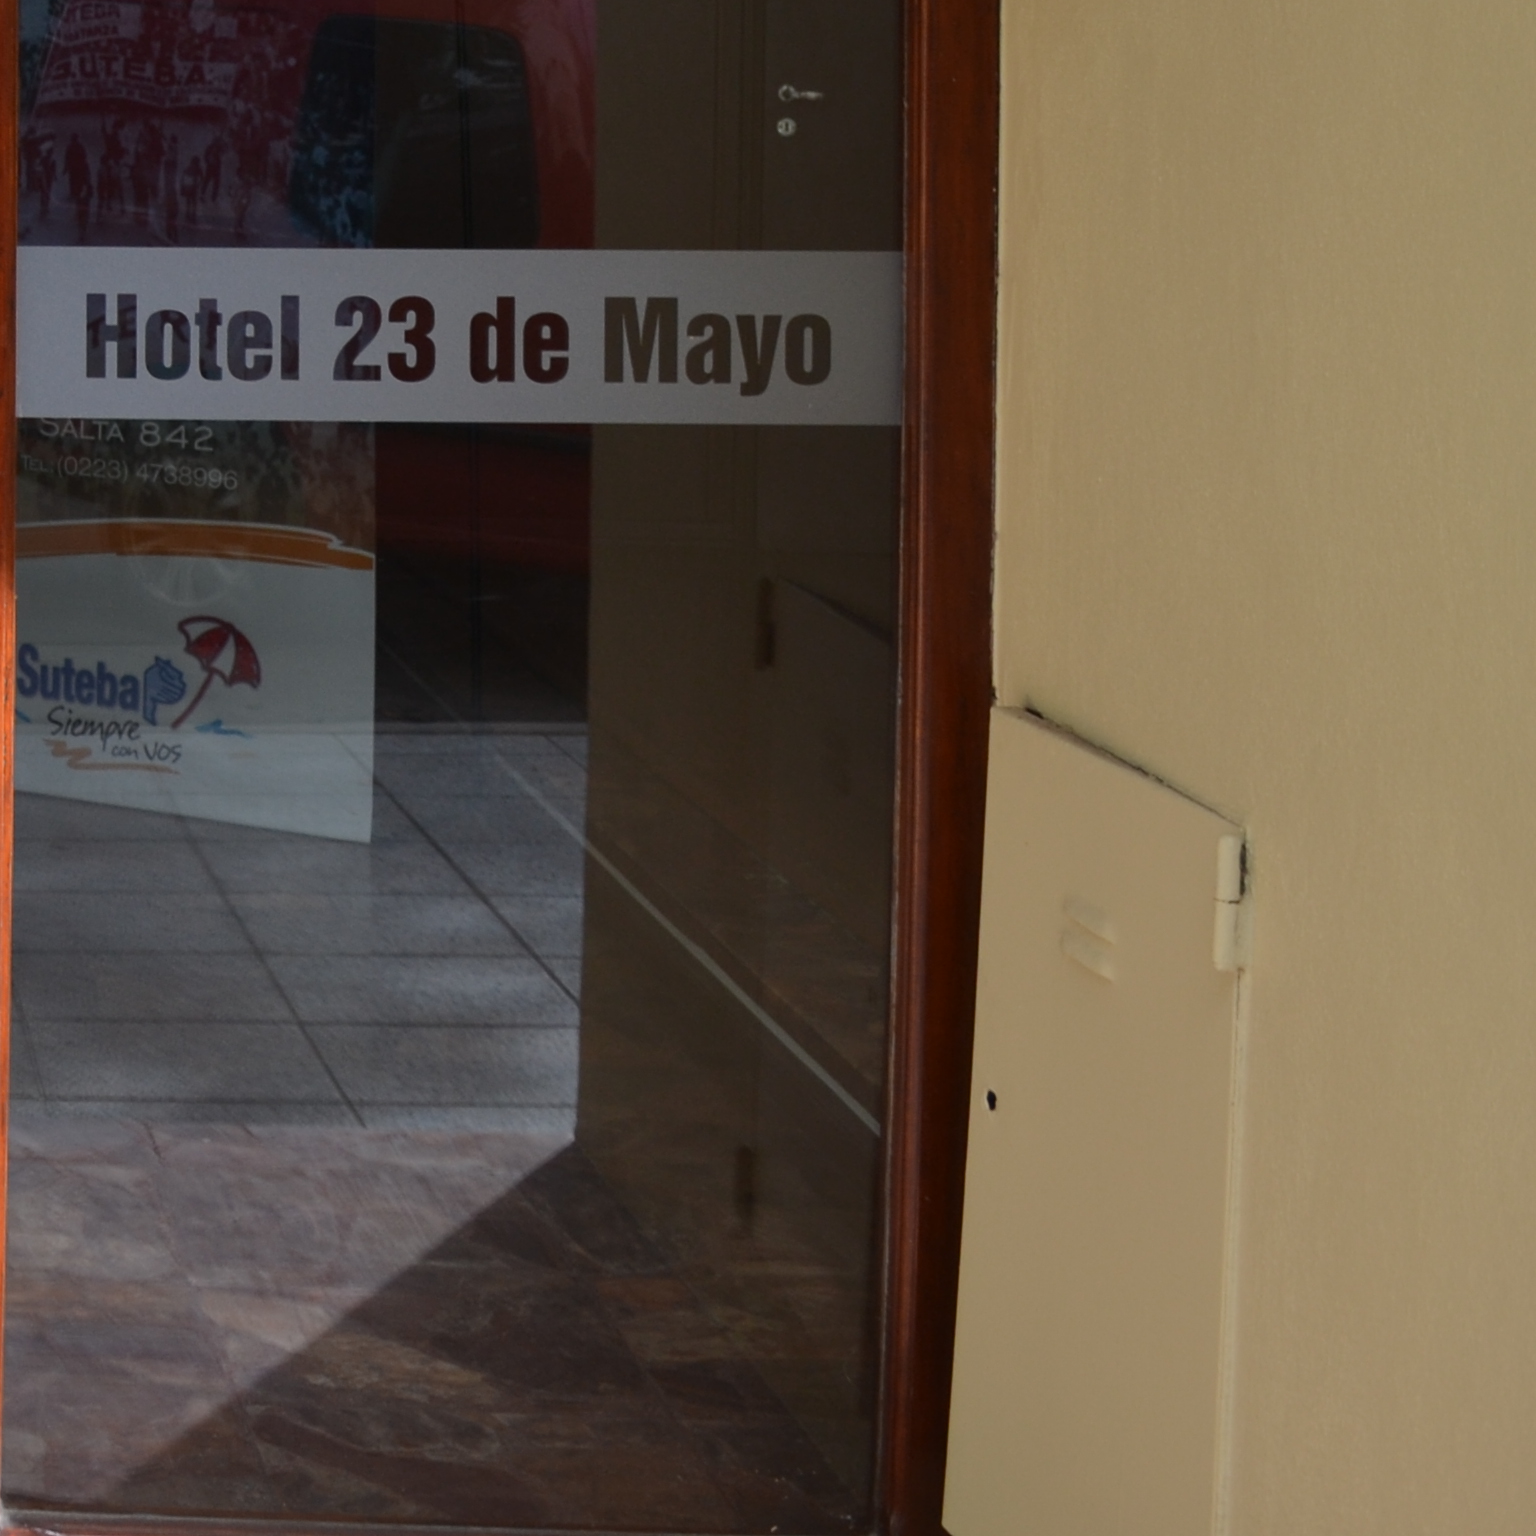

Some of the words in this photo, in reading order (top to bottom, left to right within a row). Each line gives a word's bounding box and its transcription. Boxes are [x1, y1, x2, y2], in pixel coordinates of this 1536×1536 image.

[85, 292, 301, 382] Hotel
[332, 296, 436, 383] 23
[469, 296, 570, 384] de
[604, 296, 833, 397] Mayo
[38, 418, 125, 443] SALTA
[138, 421, 215, 452] 842
[136, 463, 239, 491] 4738996
[16, 642, 141, 712] Suteba
[46, 704, 141, 752] Siempre
[110, 743, 140, 759] con
